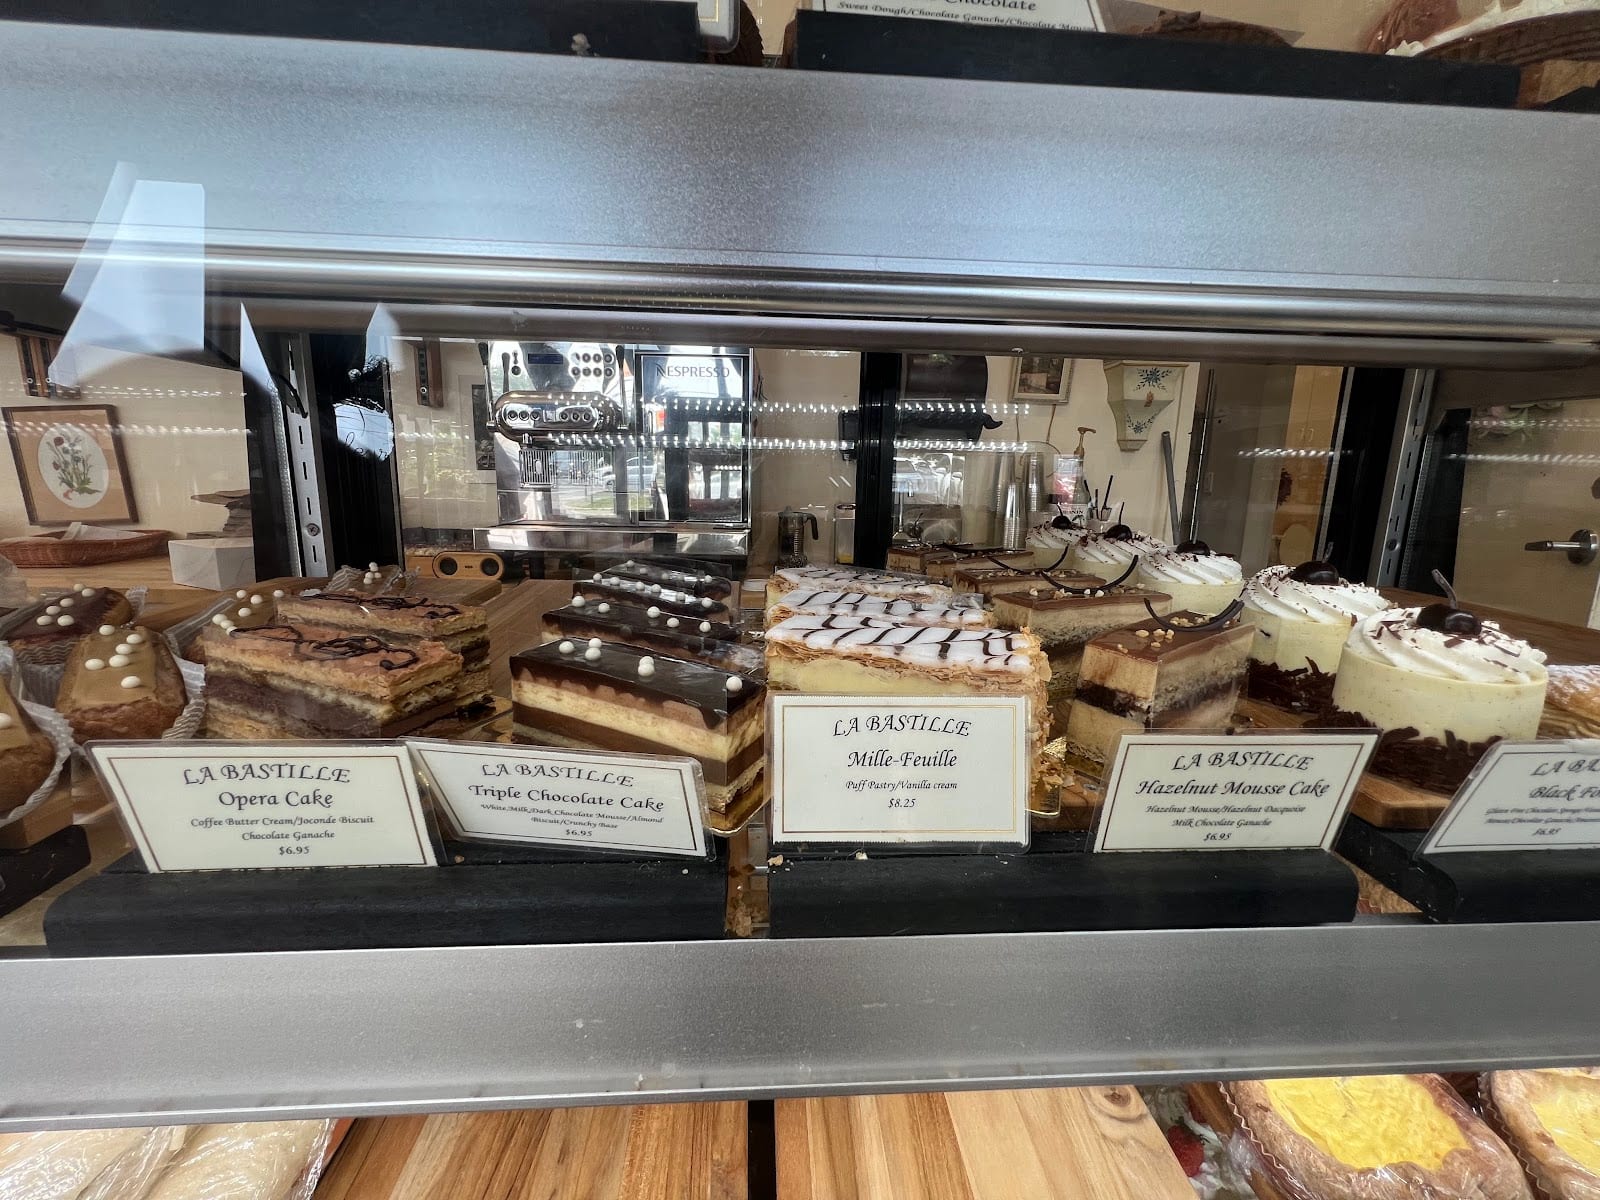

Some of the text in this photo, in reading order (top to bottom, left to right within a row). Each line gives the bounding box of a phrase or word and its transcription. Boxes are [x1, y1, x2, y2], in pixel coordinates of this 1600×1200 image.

[838, 1, 868, 10] Sweet
[872, 5, 960, 19] Dough/Chocolate
[945, 0, 1037, 11] ocolate
[655, 363, 730, 378] NESPRESSO
[833, 713, 973, 737] LA BASTILLE
[847, 749, 958, 768] Mille-Feuille
[1171, 750, 1314, 771] LA BASTILLE
[183, 763, 351, 786] LA BASTILLE
[482, 763, 634, 788] LA BASTILLE
[1530, 760, 1566, 776] LA
[845, 779, 958, 792] Puff Pastry/Vanilla cream
[1135, 778, 1330, 798] Hazelnut Mousse Cake
[1529, 784, 1581, 801] Black
[218, 788, 334, 811] Opera Cake
[468, 784, 665, 813] Triple Chocolate Cake
[888, 798, 916, 809] $8.25
[554, 809, 594, 819] Chocolate
[595, 812, 664, 824] Mousse/Almond
[1145, 804, 1186, 814] Hazelnut
[1187, 804, 1262, 815] Mousse/Hazelnut
[191, 815, 375, 828] Coffee Butter Cream/Joconde Biscuit
[531, 817, 597, 828] Biscuit/Crunchy
[1171, 818, 1273, 829] Milk Chocolate Ganache
[242, 830, 335, 841] Chocolate Ganache
[565, 829, 593, 837] $6.95
[1203, 832, 1232, 842] $6.95
[279, 845, 310, 856] $6.95
